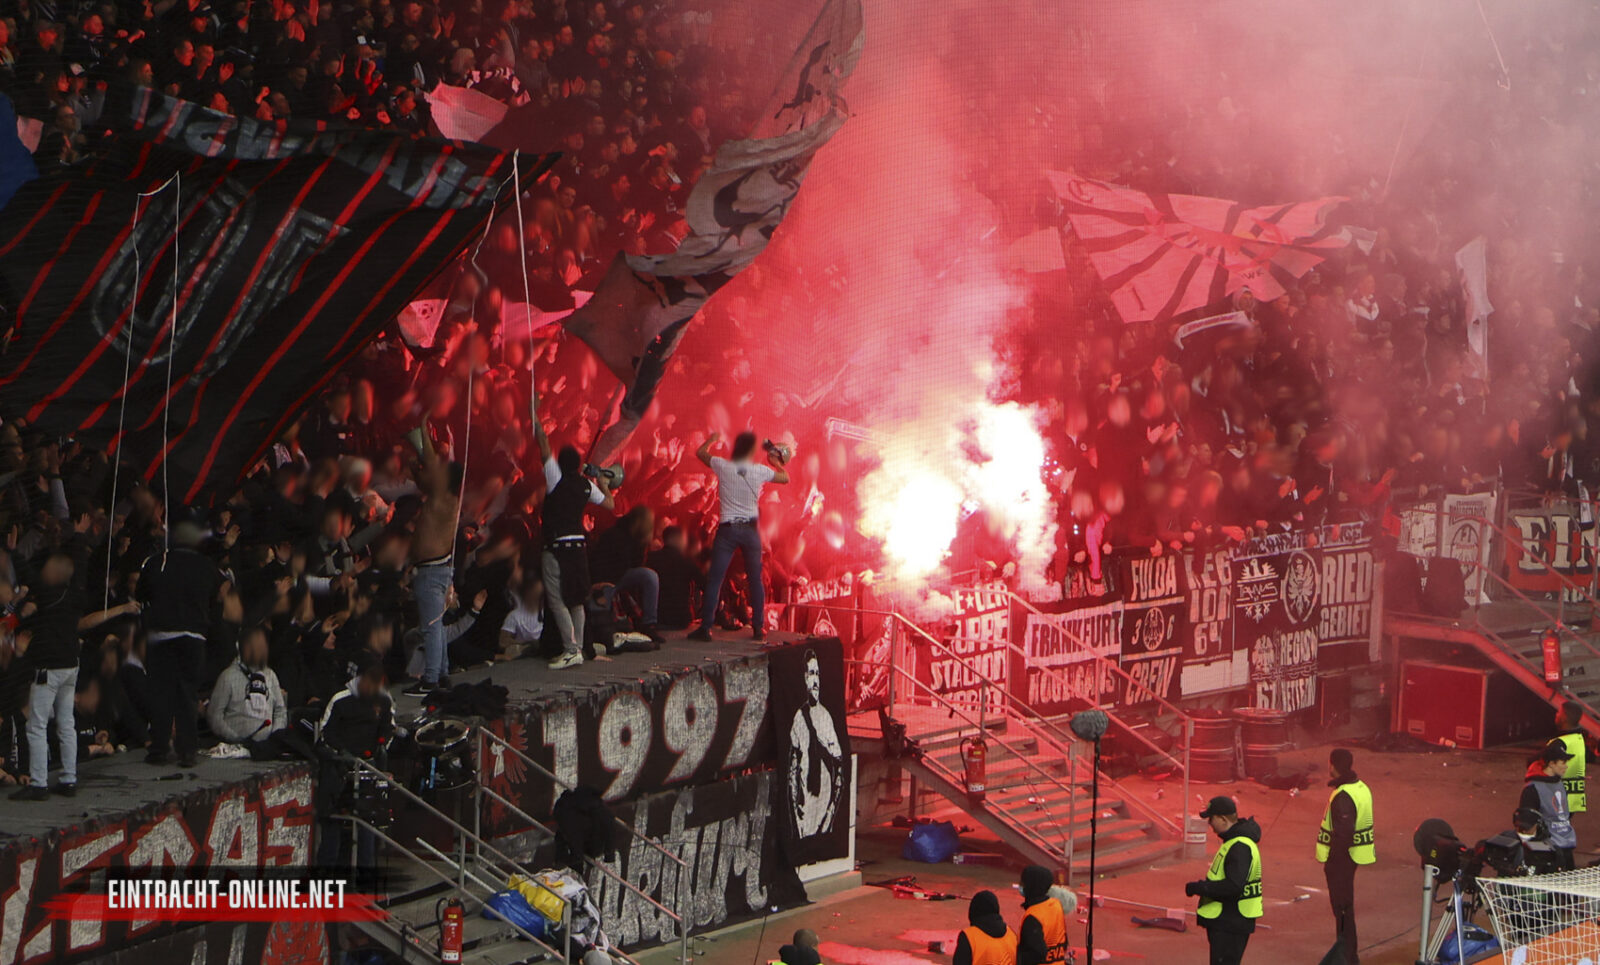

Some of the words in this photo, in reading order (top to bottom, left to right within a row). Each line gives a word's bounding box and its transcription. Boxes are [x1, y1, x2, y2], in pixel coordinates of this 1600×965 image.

[1131, 555, 1177, 601] FULDA
[1320, 552, 1374, 606] RIED
[1031, 610, 1122, 658] FRANKFURT
[1319, 604, 1371, 640] GEBIET
[930, 649, 1007, 691] STADION
[1028, 660, 1117, 706] HOOLIGANS
[1125, 657, 1177, 706] CREW
[542, 654, 771, 812] 1997
